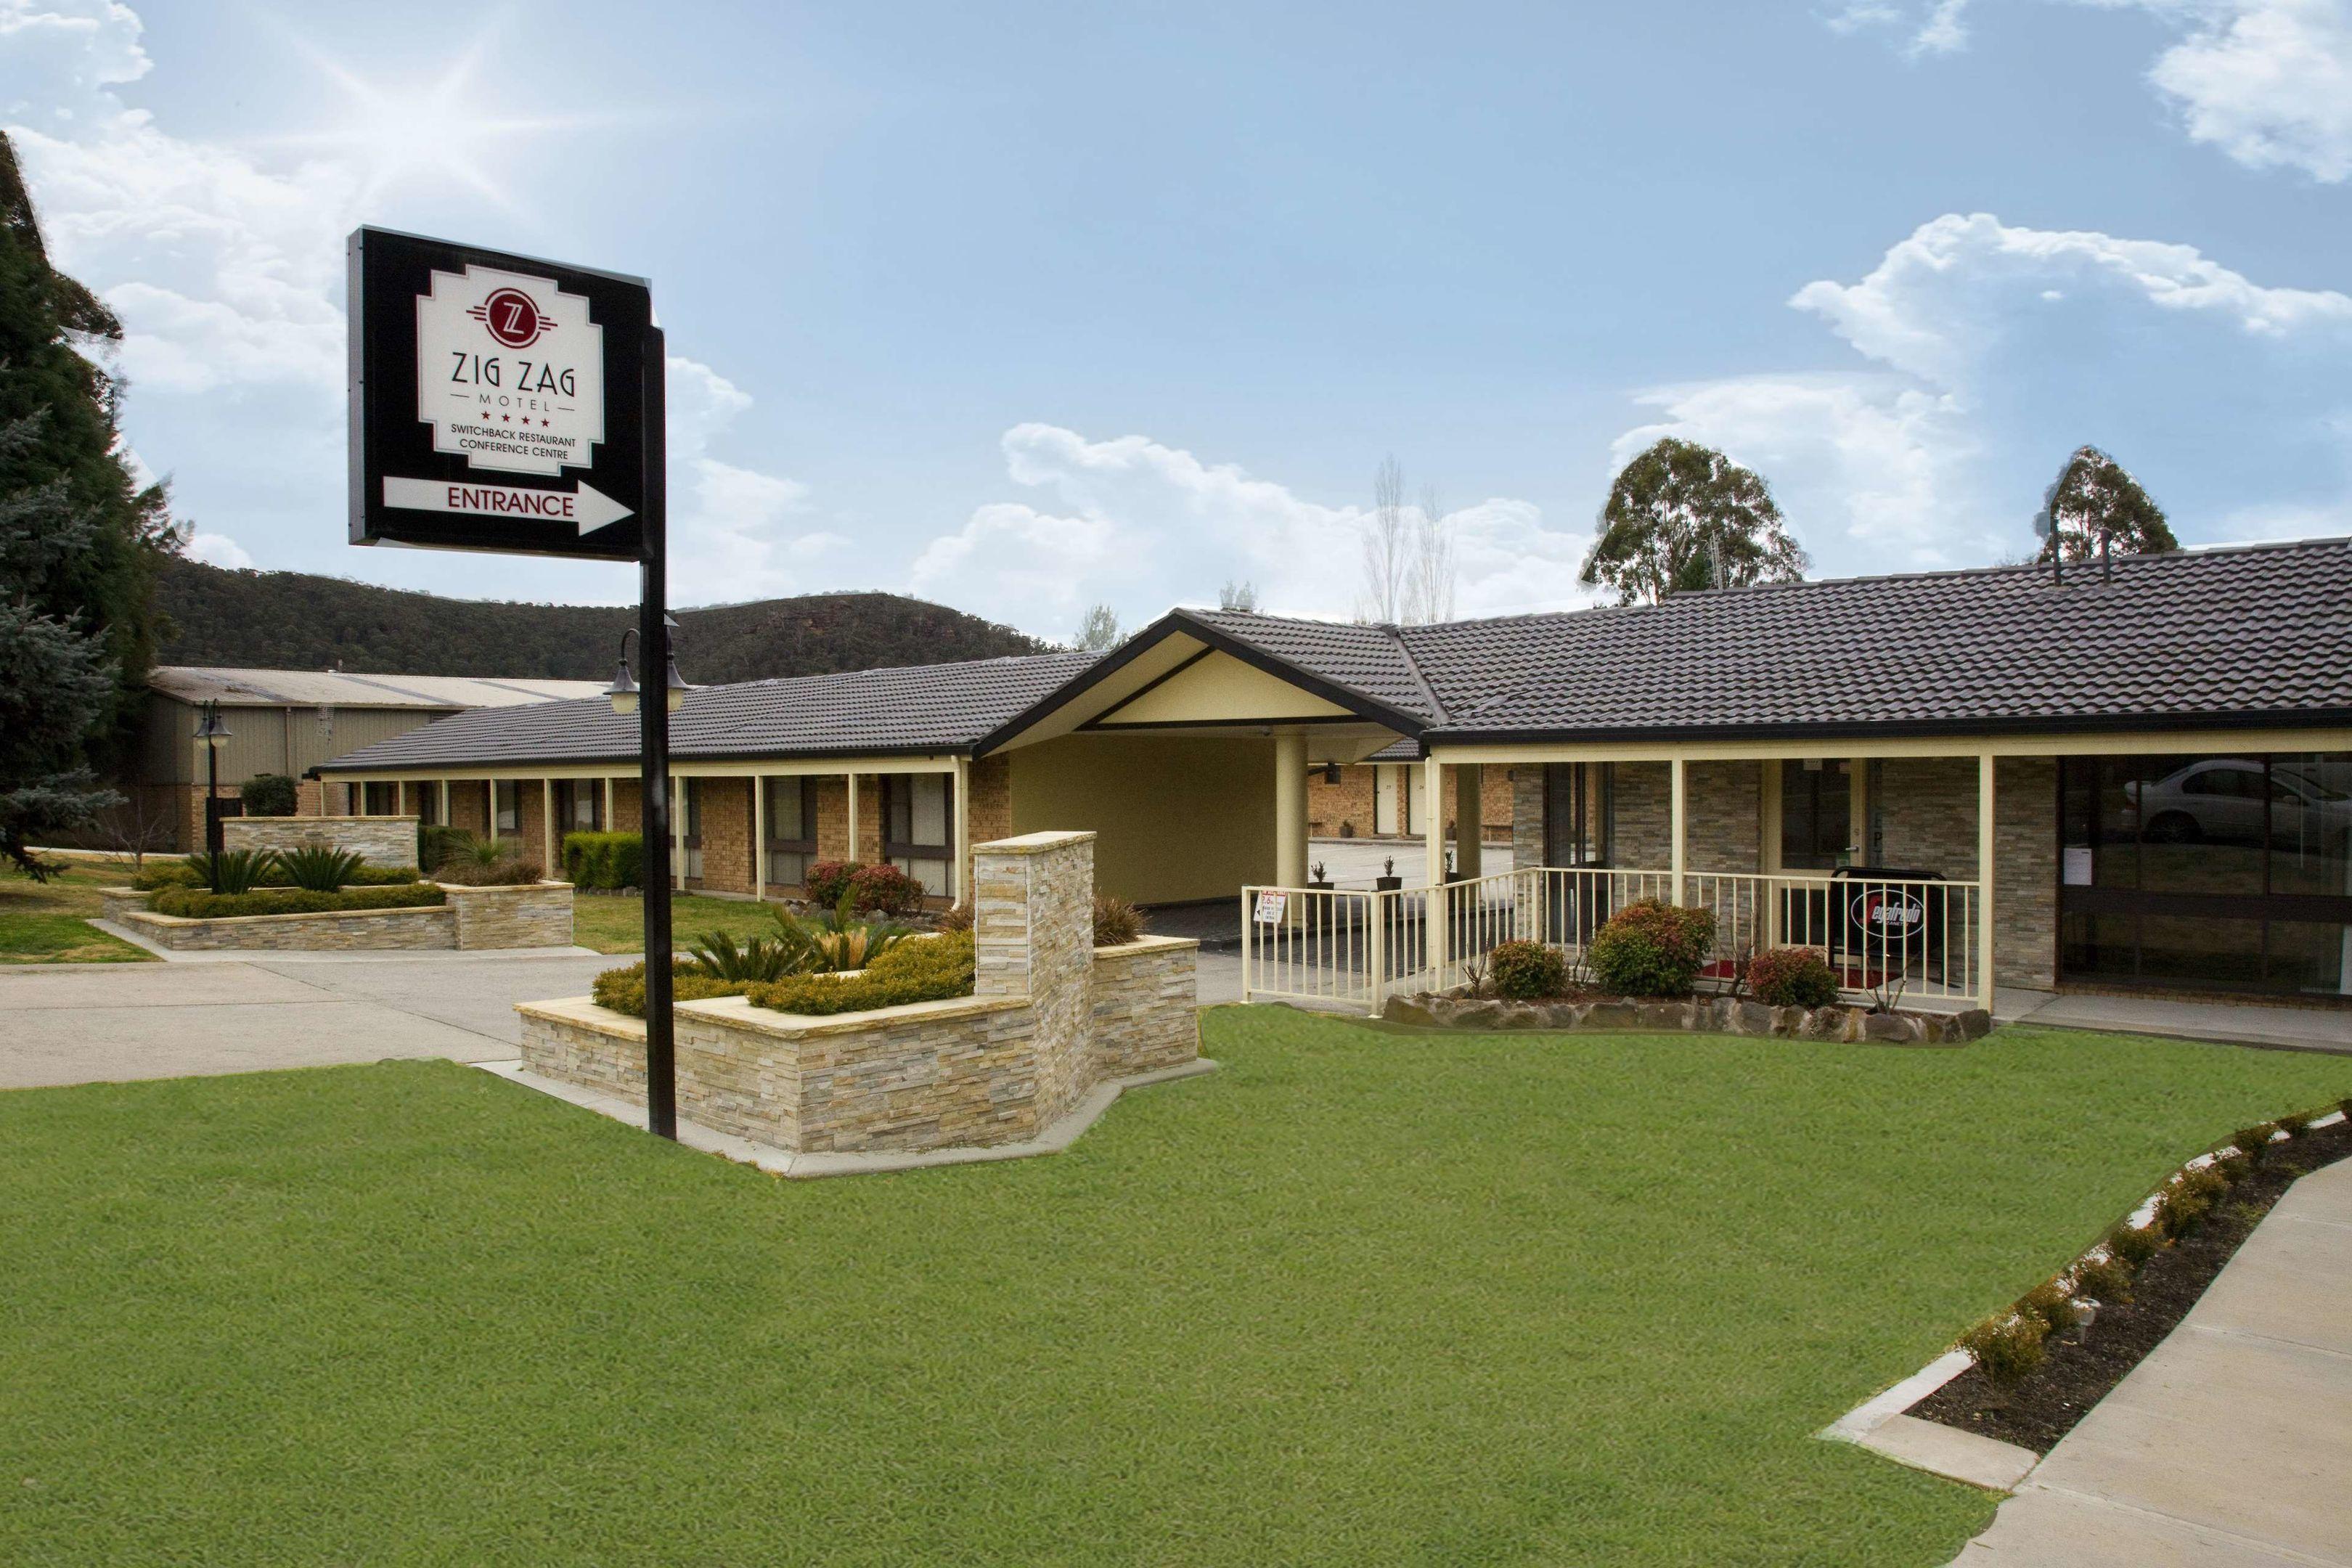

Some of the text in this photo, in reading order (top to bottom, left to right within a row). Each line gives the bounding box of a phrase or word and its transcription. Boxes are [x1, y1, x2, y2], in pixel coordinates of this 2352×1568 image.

[452, 351, 575, 398] ZIG ZAG
[479, 393, 550, 412] MOTEL
[451, 423, 576, 447] SWITCHBACK RESTAURANT
[460, 438, 568, 460] CONFERENCE CENTRE
[448, 486, 573, 517] ENTRANCE
